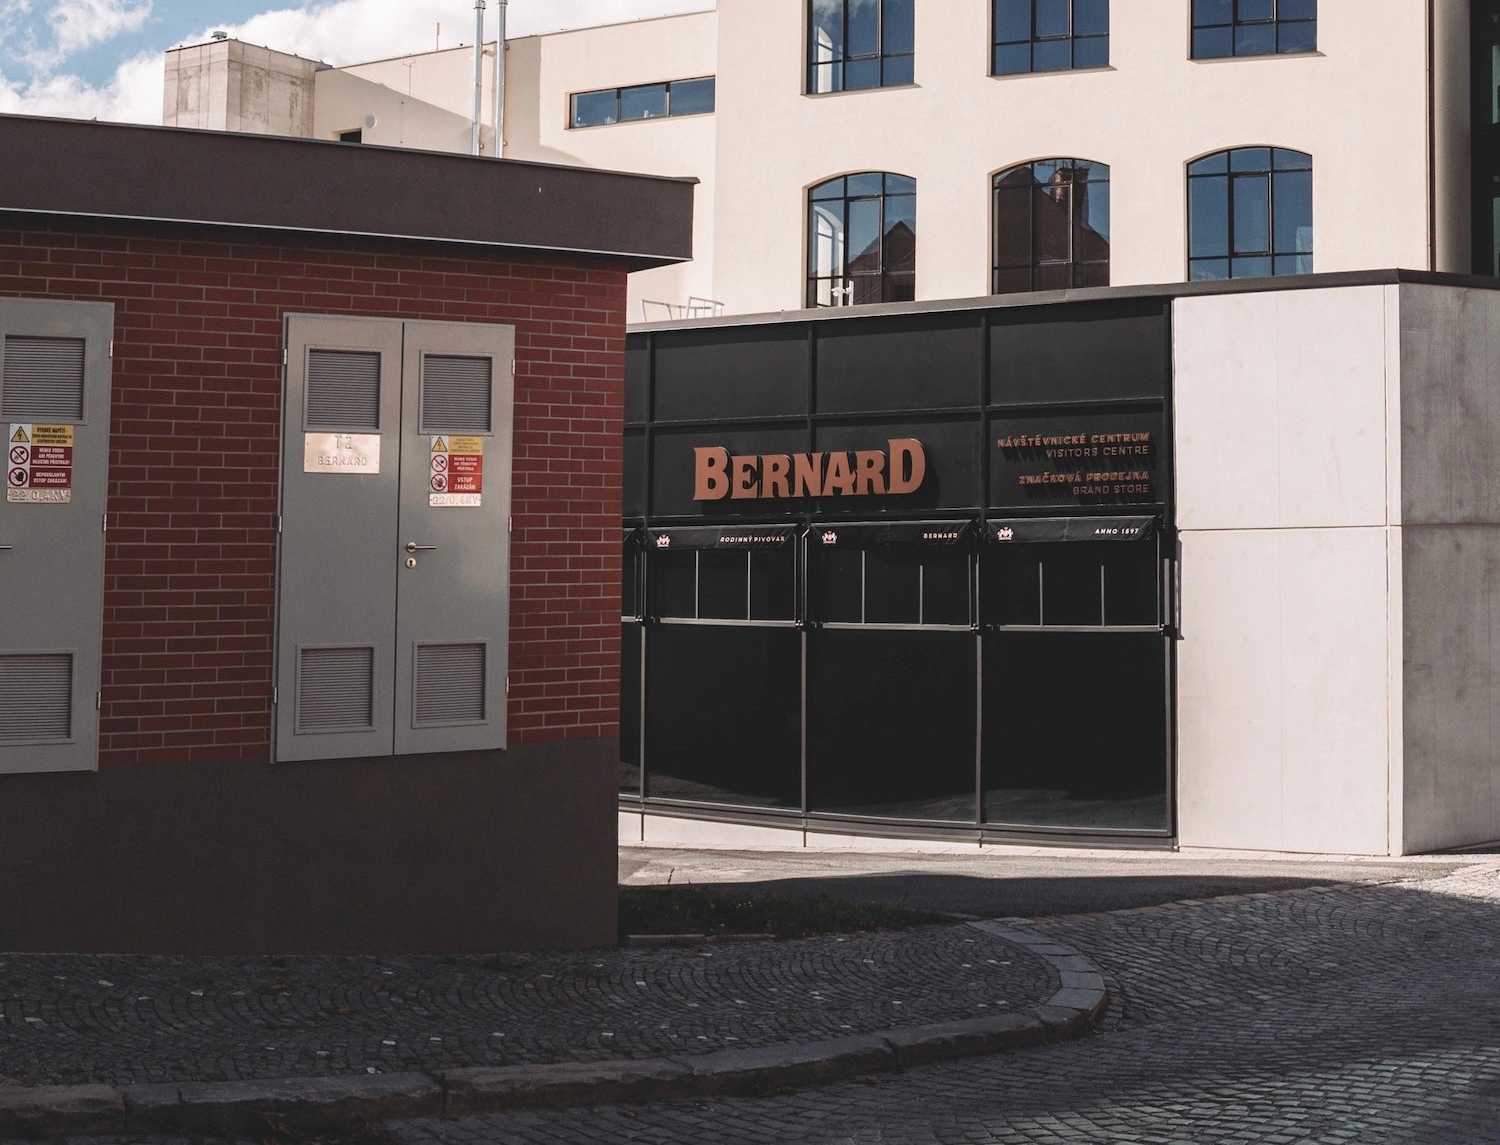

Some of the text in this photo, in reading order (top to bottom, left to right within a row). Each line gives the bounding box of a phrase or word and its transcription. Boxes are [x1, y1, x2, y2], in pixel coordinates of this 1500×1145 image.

[997, 432, 1150, 448] NÁVŠTĚVNICKÉ CENTRUM
[1046, 445, 1149, 458] VISITORS CENTRE
[317, 455, 368, 466] BERNARD
[693, 438, 926, 501] BERNARD
[1018, 471, 1149, 485] ZNAČKOVÁ PRODEJNA
[1072, 484, 1149, 495] BRAND STORE
[719, 535, 753, 543] RODINNÝ
